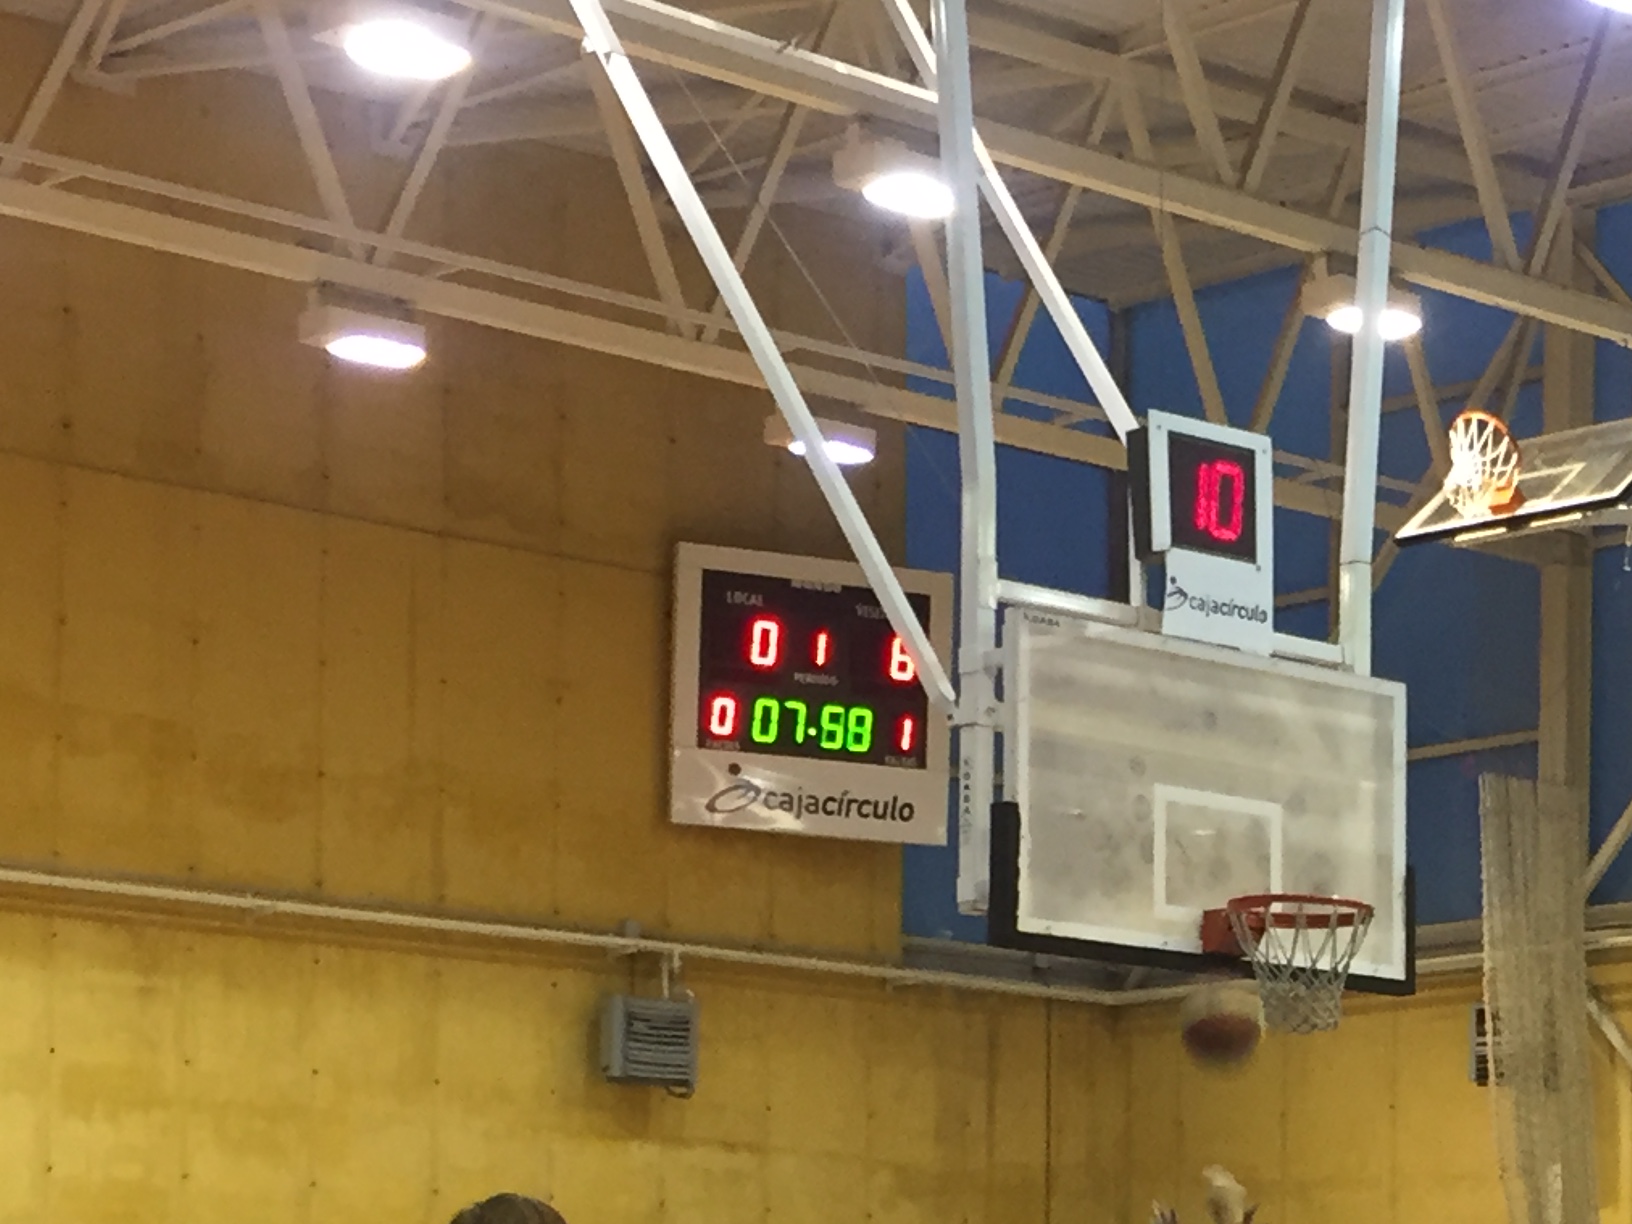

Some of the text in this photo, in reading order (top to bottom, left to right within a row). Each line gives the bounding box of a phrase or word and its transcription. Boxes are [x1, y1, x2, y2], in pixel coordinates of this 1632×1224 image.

[1195, 459, 1245, 541] 10
[1188, 593, 1268, 624] cajacírculo
[749, 618, 779, 667] 0
[815, 632, 828, 666] 1
[709, 696, 736, 737] 0
[901, 717, 913, 751] 1
[763, 786, 915, 822] cajacírculo
